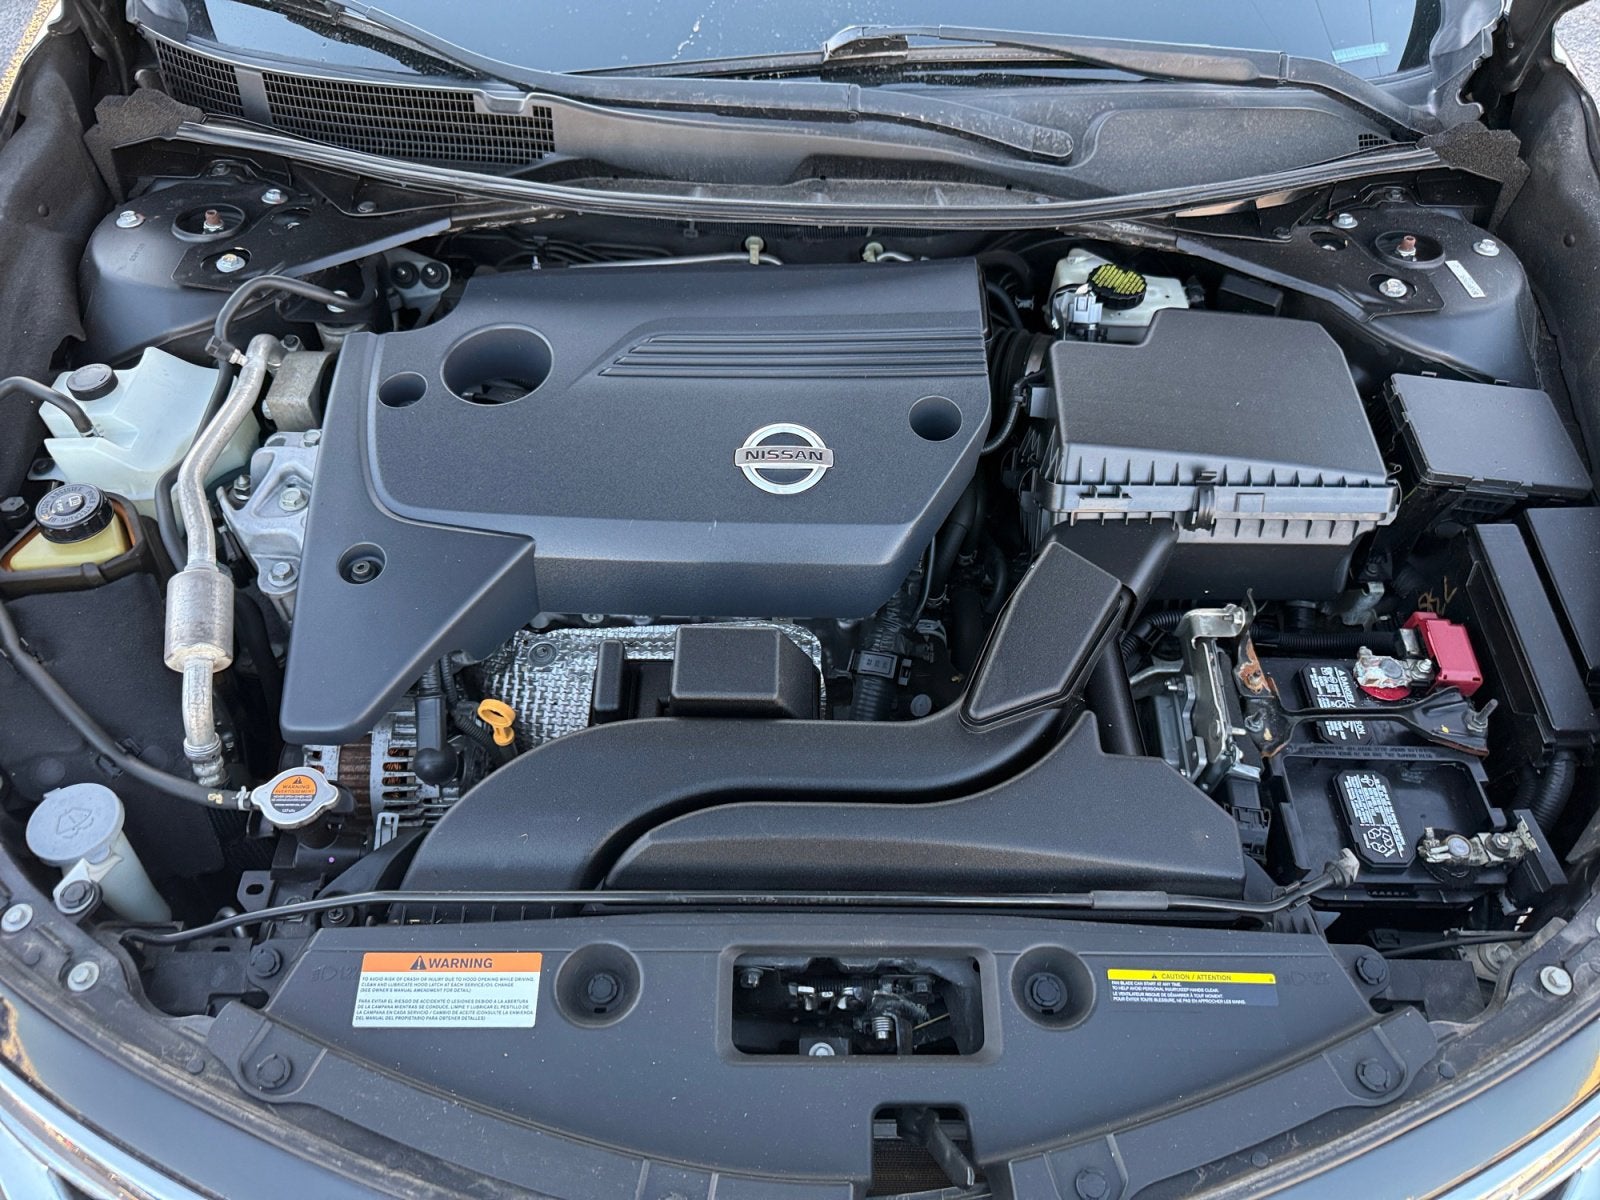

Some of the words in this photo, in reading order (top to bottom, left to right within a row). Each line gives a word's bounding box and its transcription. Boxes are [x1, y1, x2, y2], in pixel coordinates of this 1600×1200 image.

[745, 450, 823, 461] NISSAN
[1341, 676, 1355, 703] DANGER
[429, 958, 493, 969] WARNING
